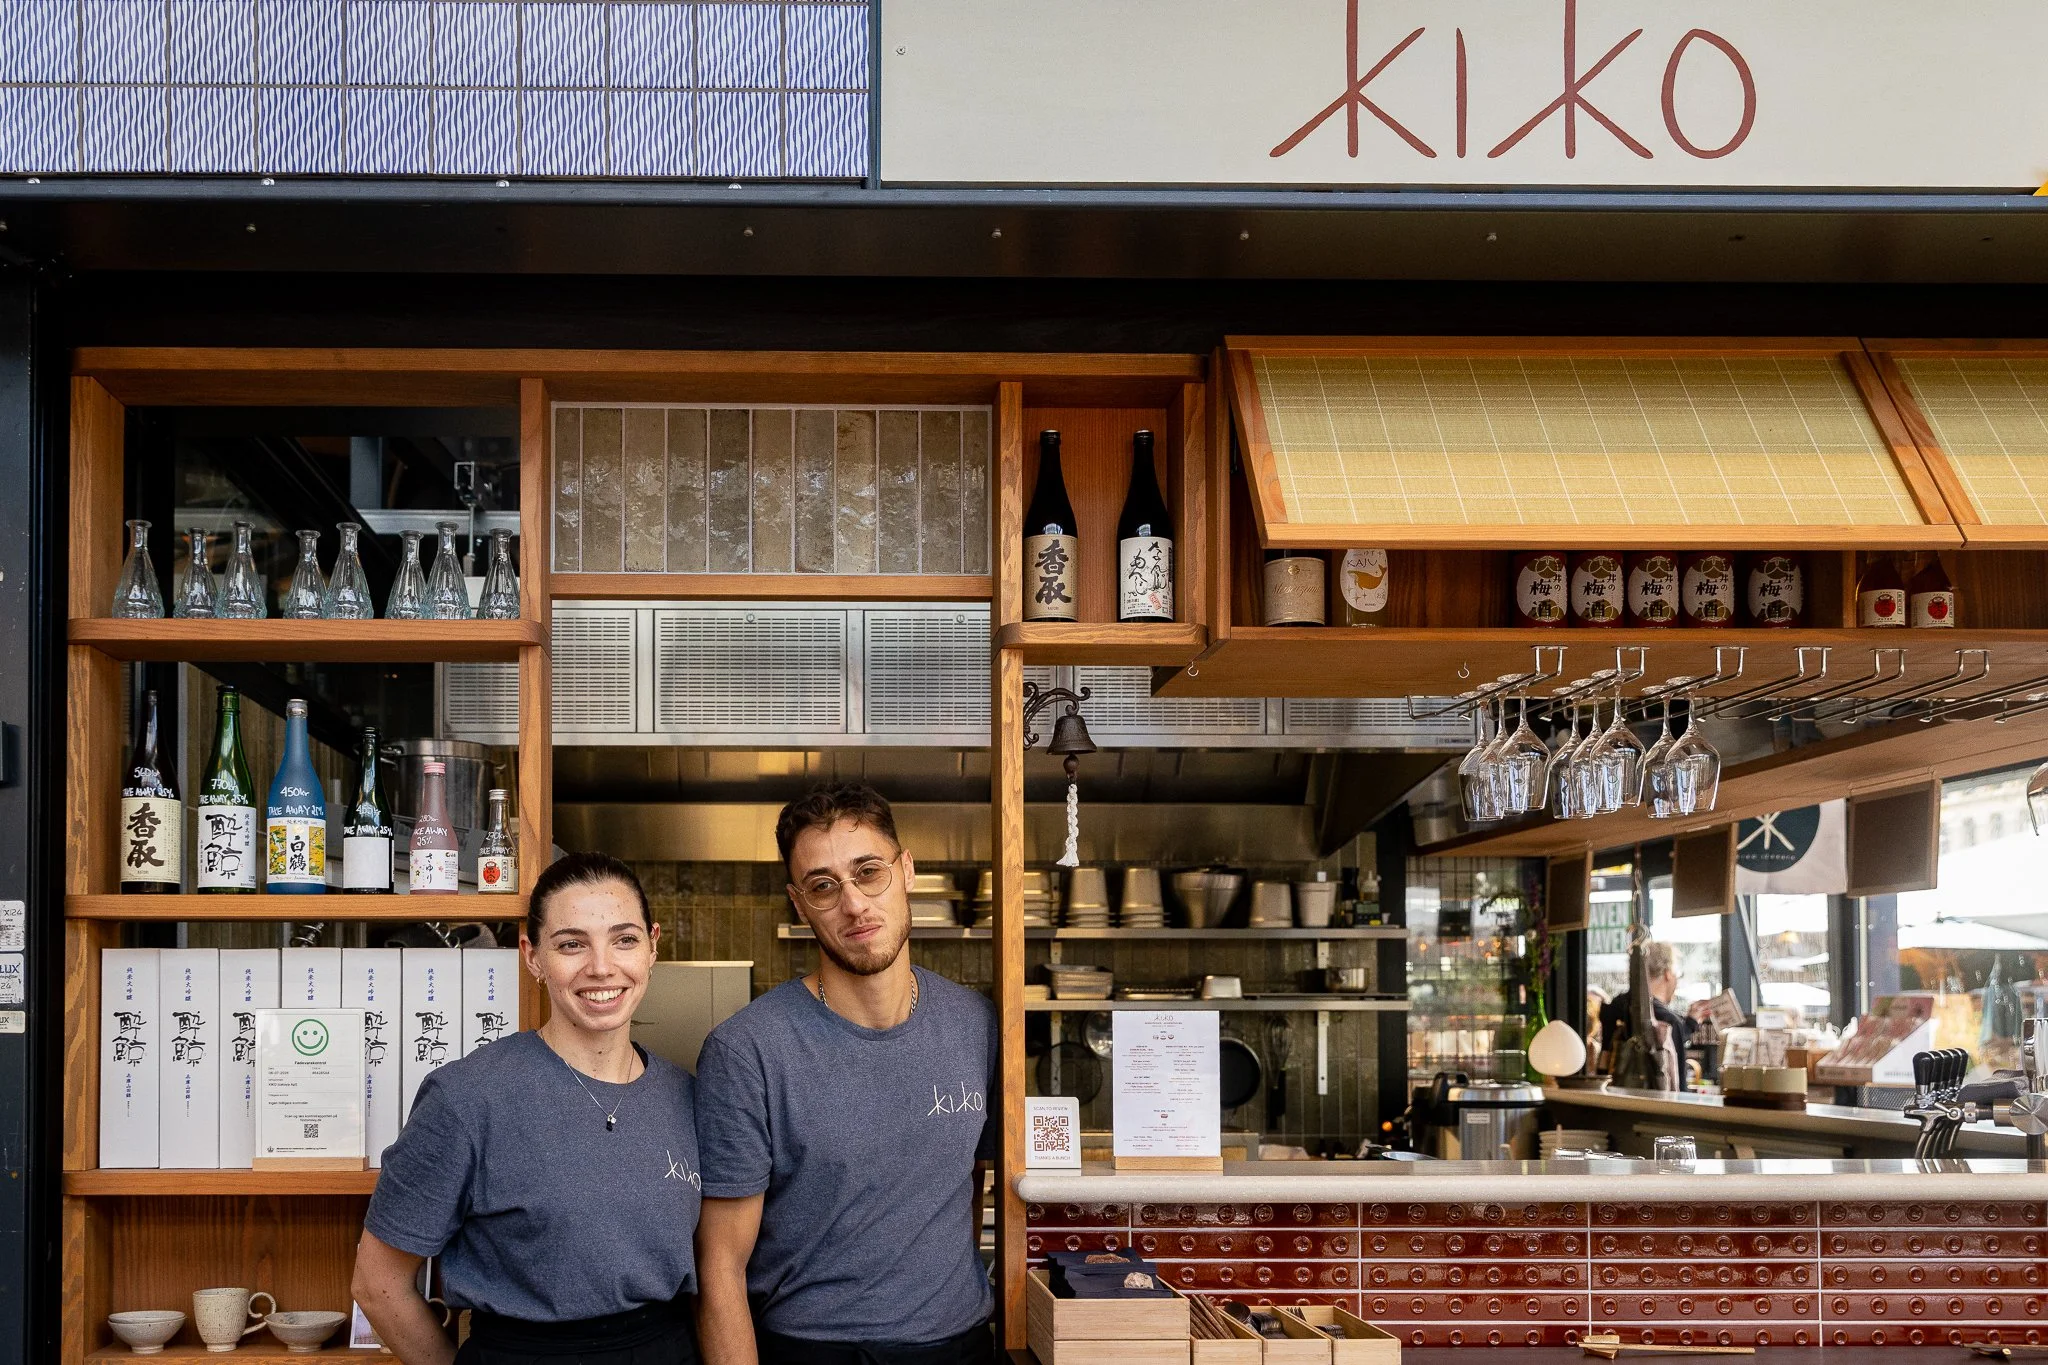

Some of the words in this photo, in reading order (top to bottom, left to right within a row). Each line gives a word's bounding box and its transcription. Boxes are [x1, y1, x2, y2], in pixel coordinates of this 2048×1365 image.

[1269, 0, 1757, 159] kiko
[1035, 539, 1072, 605] 香取
[1530, 578, 1552, 617] 梅酒
[1583, 578, 1606, 617] 梅酒
[1640, 578, 1664, 618] 梅酒
[1695, 578, 1719, 618] 梅酒
[1759, 579, 1783, 618] 梅酒
[135, 787, 156, 797] AWAY
[209, 794, 229, 804] AWAY
[280, 786, 310, 797] 450kr
[285, 805, 310, 816] AWAY
[126, 802, 165, 869] 香取
[380, 826, 393, 837] 25%
[417, 836, 433, 846] 25%
[425, 827, 448, 836] AWAY
[289, 835, 307, 871] 白鶴
[425, 852, 434, 884] さゆり
[927, 1081, 983, 1117] kiko
